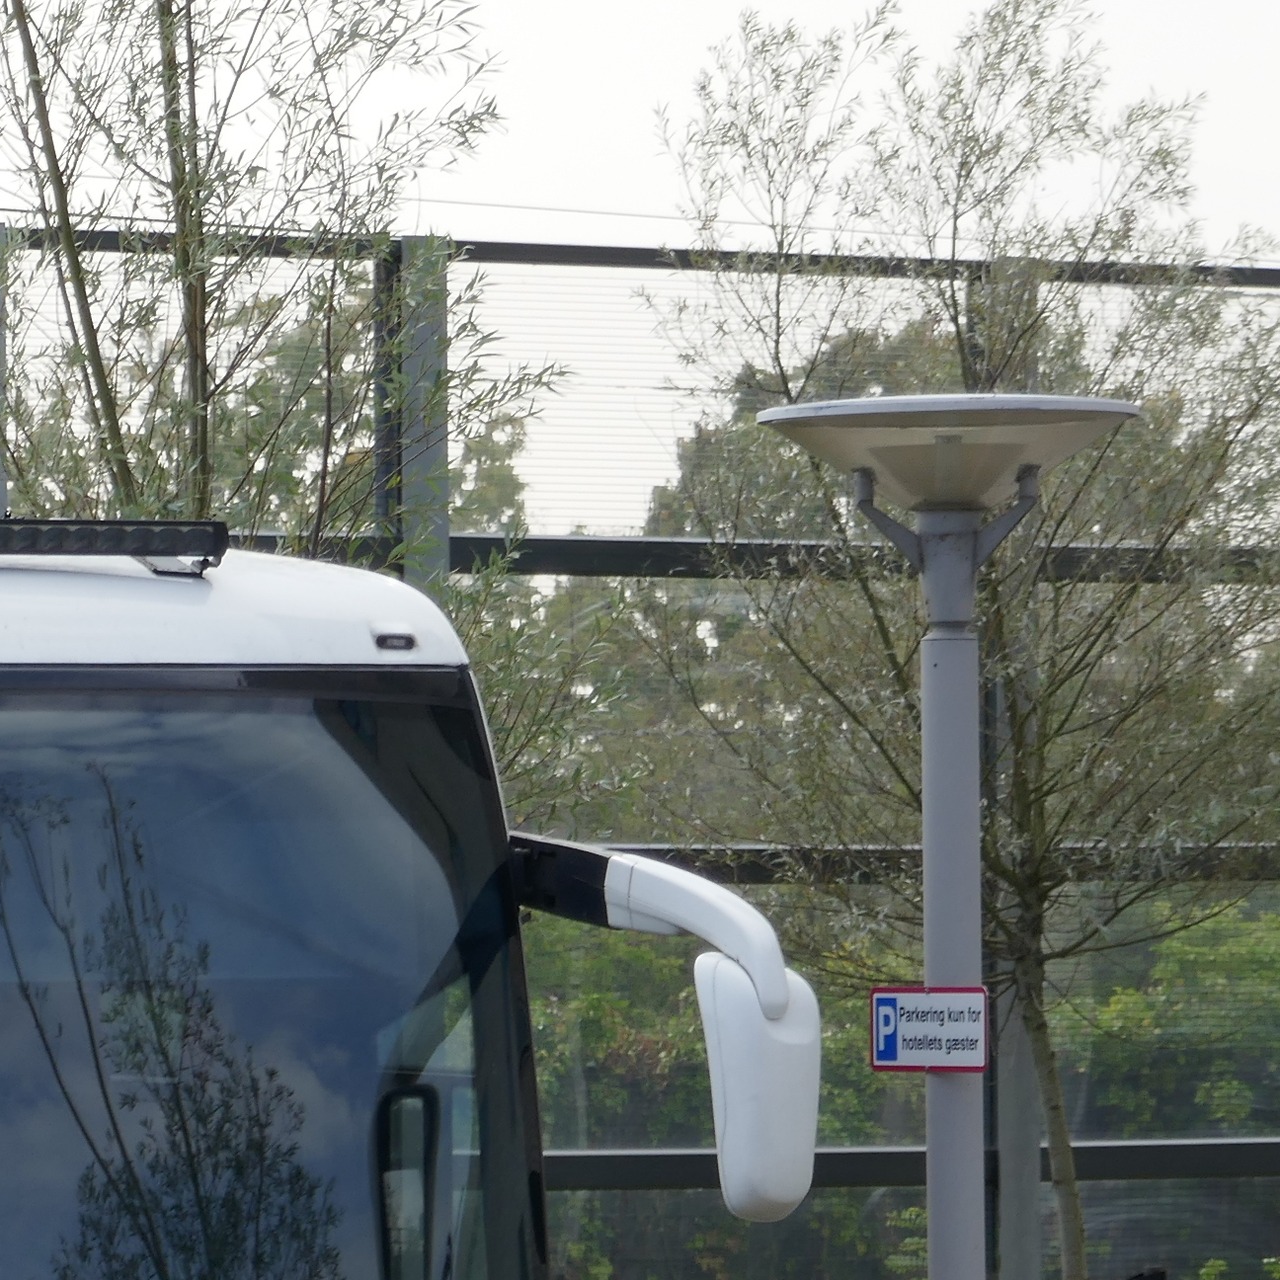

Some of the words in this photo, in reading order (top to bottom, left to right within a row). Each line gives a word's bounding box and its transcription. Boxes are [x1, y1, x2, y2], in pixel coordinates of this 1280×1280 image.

[899, 1006, 945, 1027] Parkering
[947, 1007, 965, 1022] kun
[967, 1006, 982, 1022] for
[878, 1006, 896, 1051] P
[901, 1035, 943, 1051] hotellets
[945, 1035, 979, 1055] gæster
